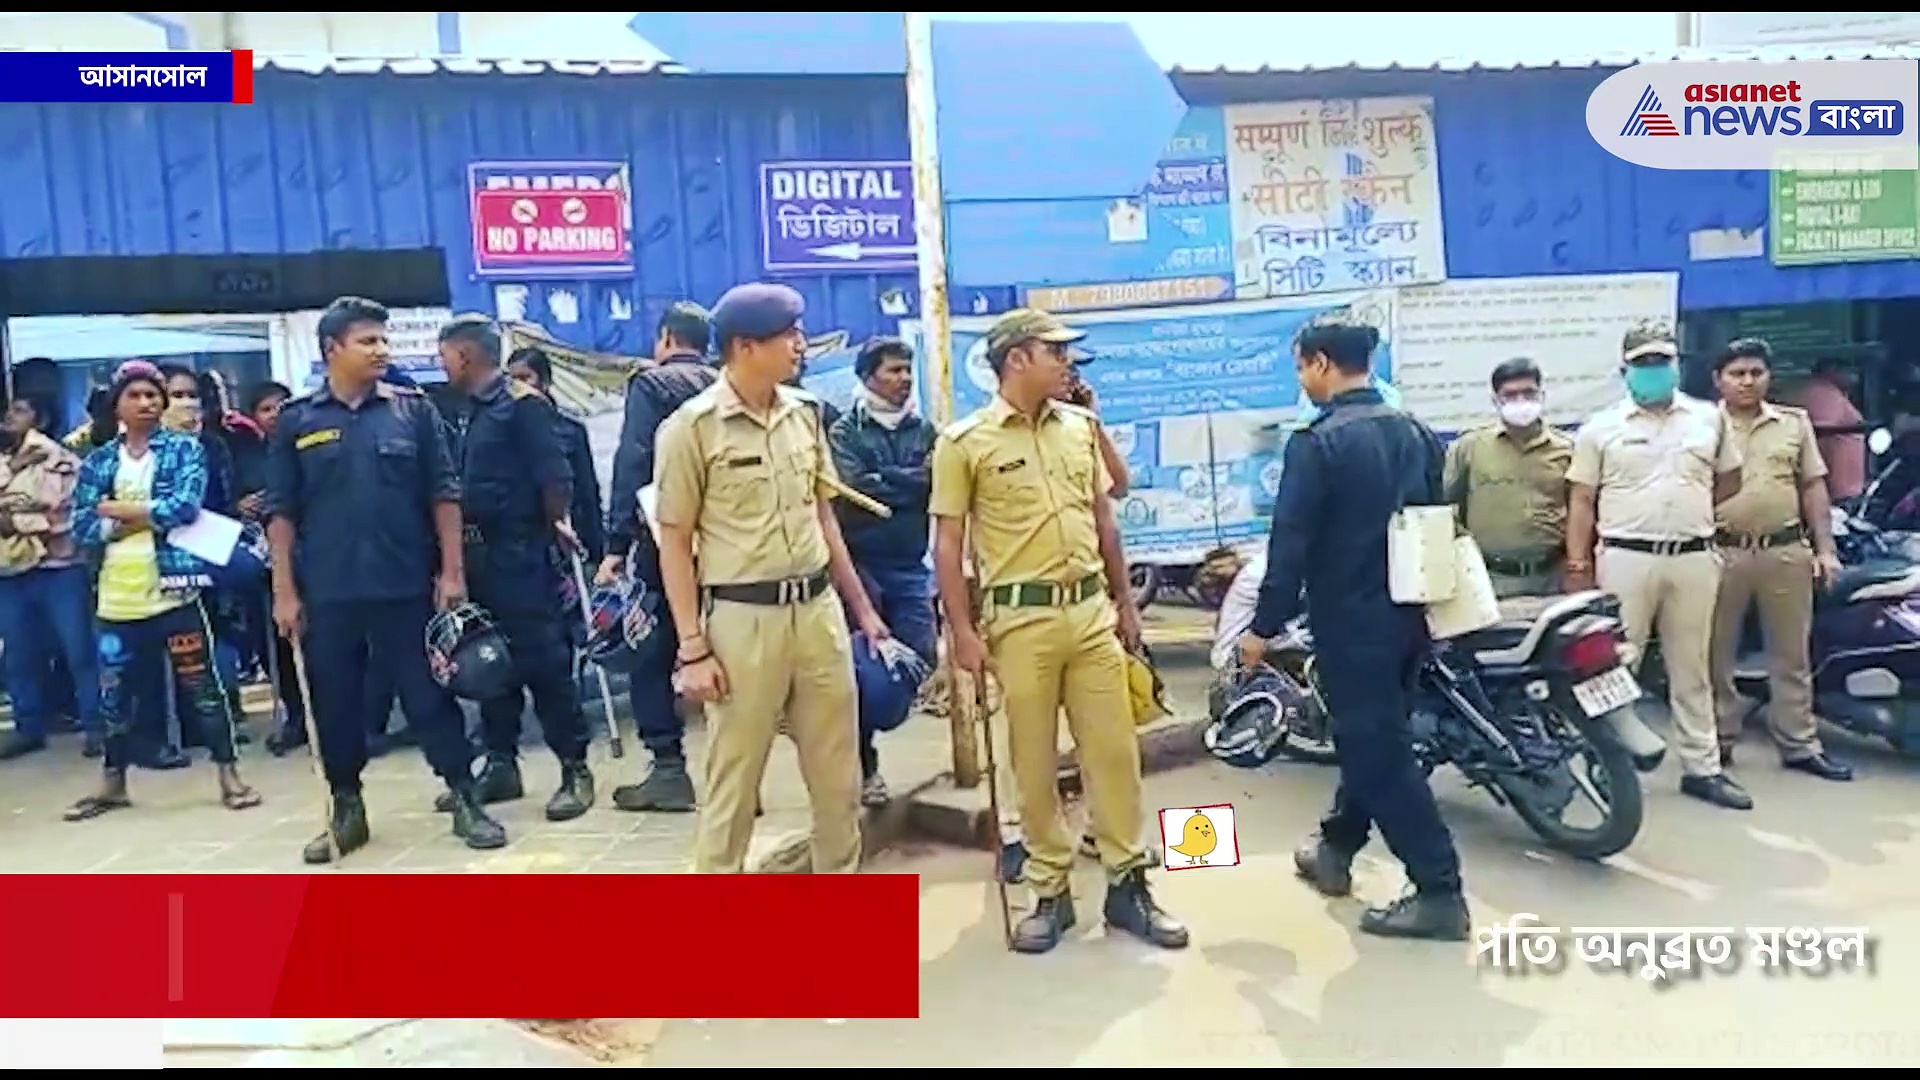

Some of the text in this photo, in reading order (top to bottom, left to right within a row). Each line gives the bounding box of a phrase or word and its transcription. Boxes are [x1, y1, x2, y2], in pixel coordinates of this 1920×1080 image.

[772, 169, 902, 200] DIGITAL
[777, 202, 901, 240] ডিজিটাল
[487, 226, 616, 252] NO PARKING
